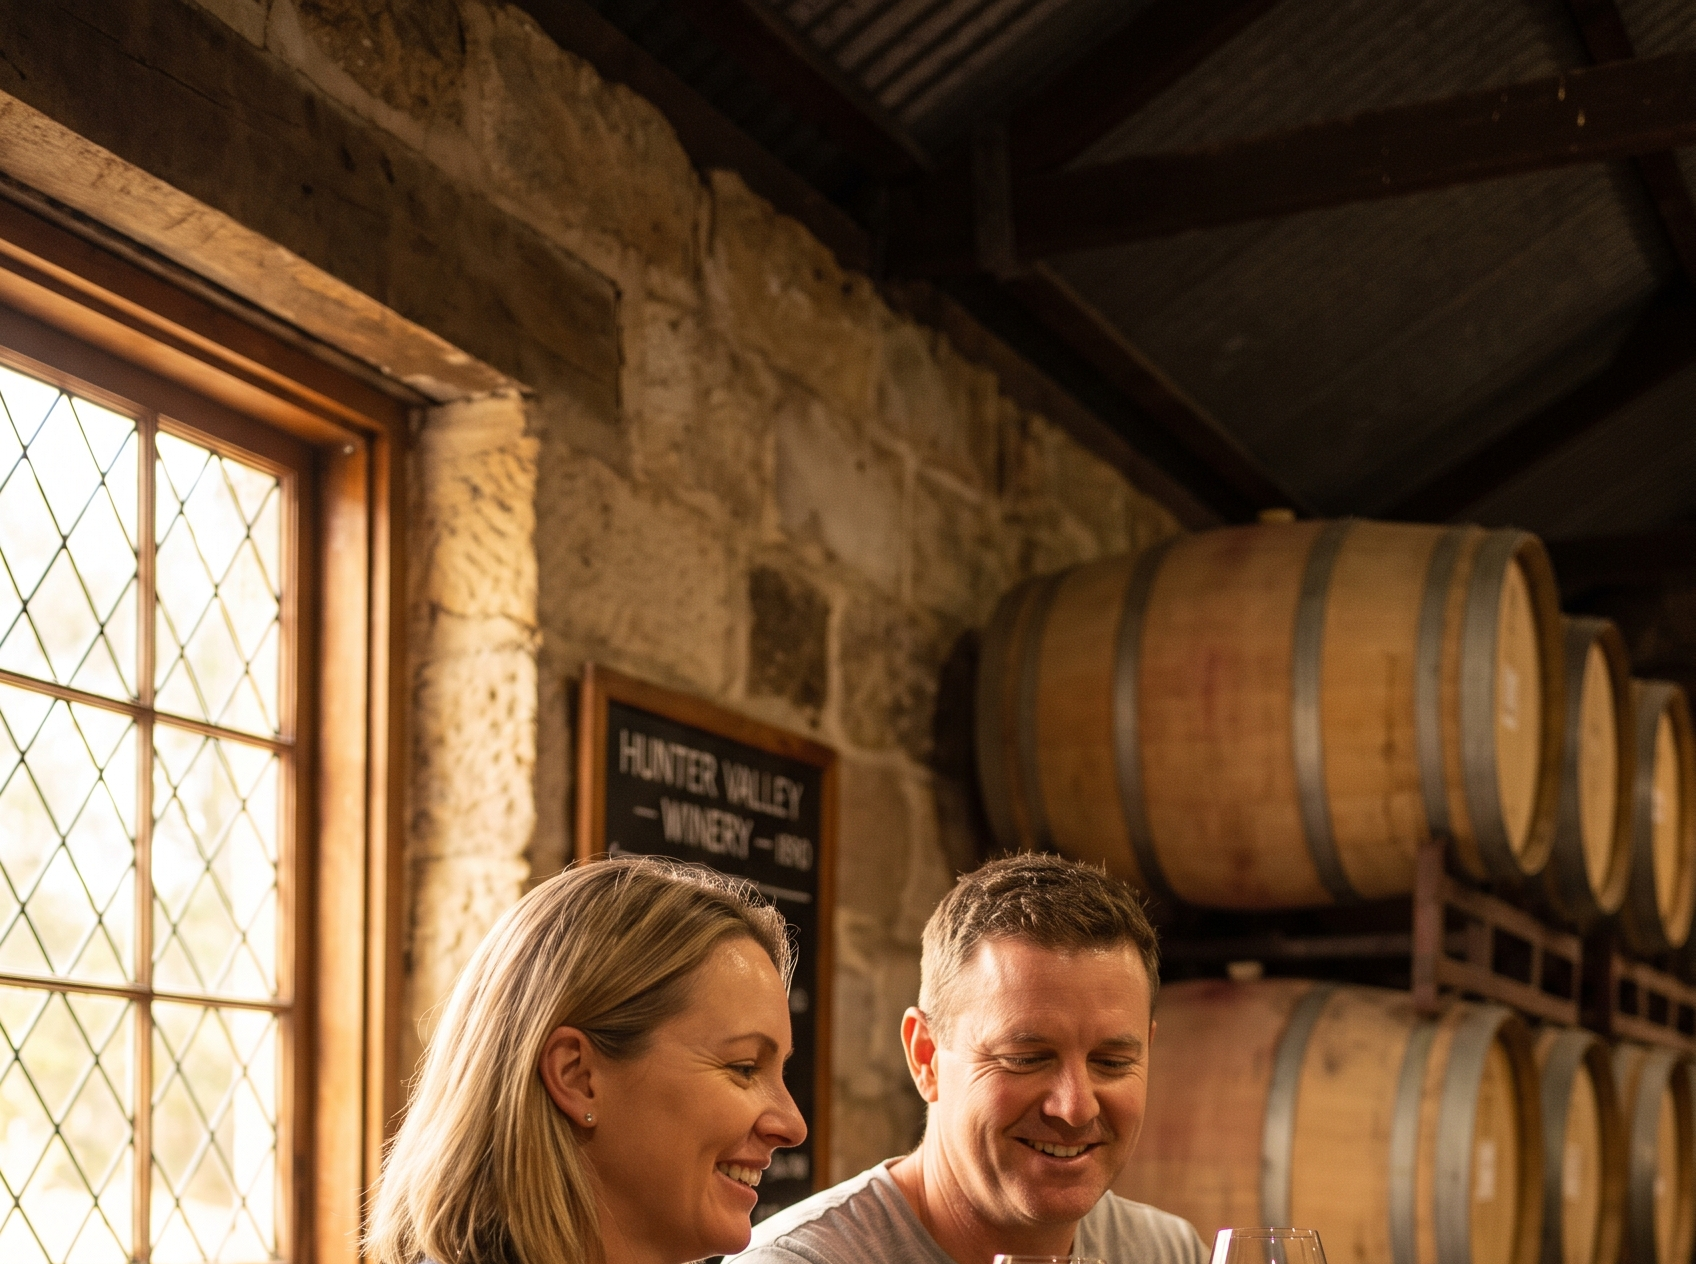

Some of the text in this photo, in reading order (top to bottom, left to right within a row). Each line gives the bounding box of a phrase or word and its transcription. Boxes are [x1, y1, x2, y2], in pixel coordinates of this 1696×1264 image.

[619, 728, 804, 821] HUNTER VALLEY
[660, 797, 754, 860] WINERY
